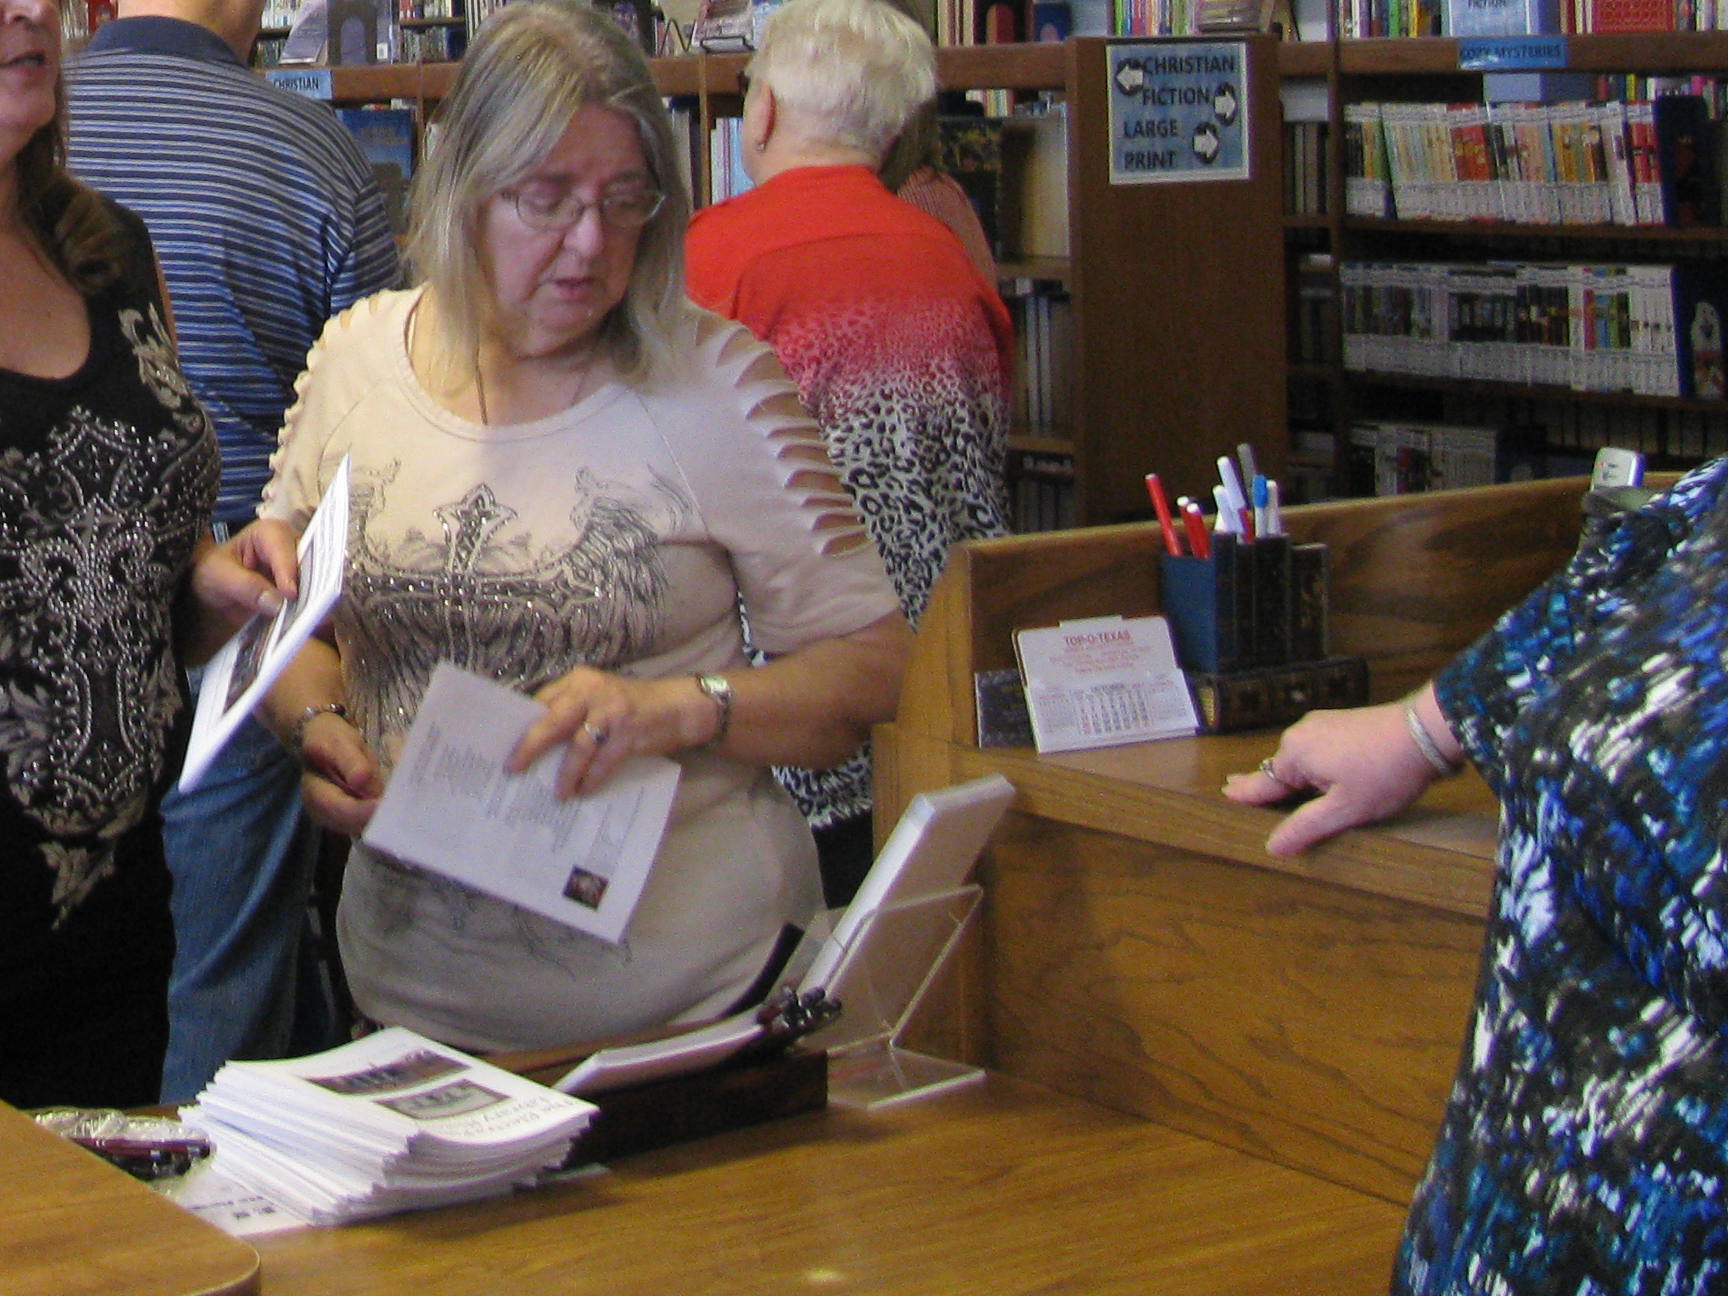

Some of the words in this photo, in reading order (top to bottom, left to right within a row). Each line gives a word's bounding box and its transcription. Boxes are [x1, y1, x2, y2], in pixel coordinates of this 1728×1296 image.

[1496, 44, 1562, 59] MYSTERIES
[1143, 56, 1234, 74] CHRISTIAN
[274, 76, 319, 91] CHRISTIAN
[1143, 88, 1210, 105] FICTION
[1124, 119, 1177, 138] LARGE
[1125, 151, 1175, 169] PRINT
